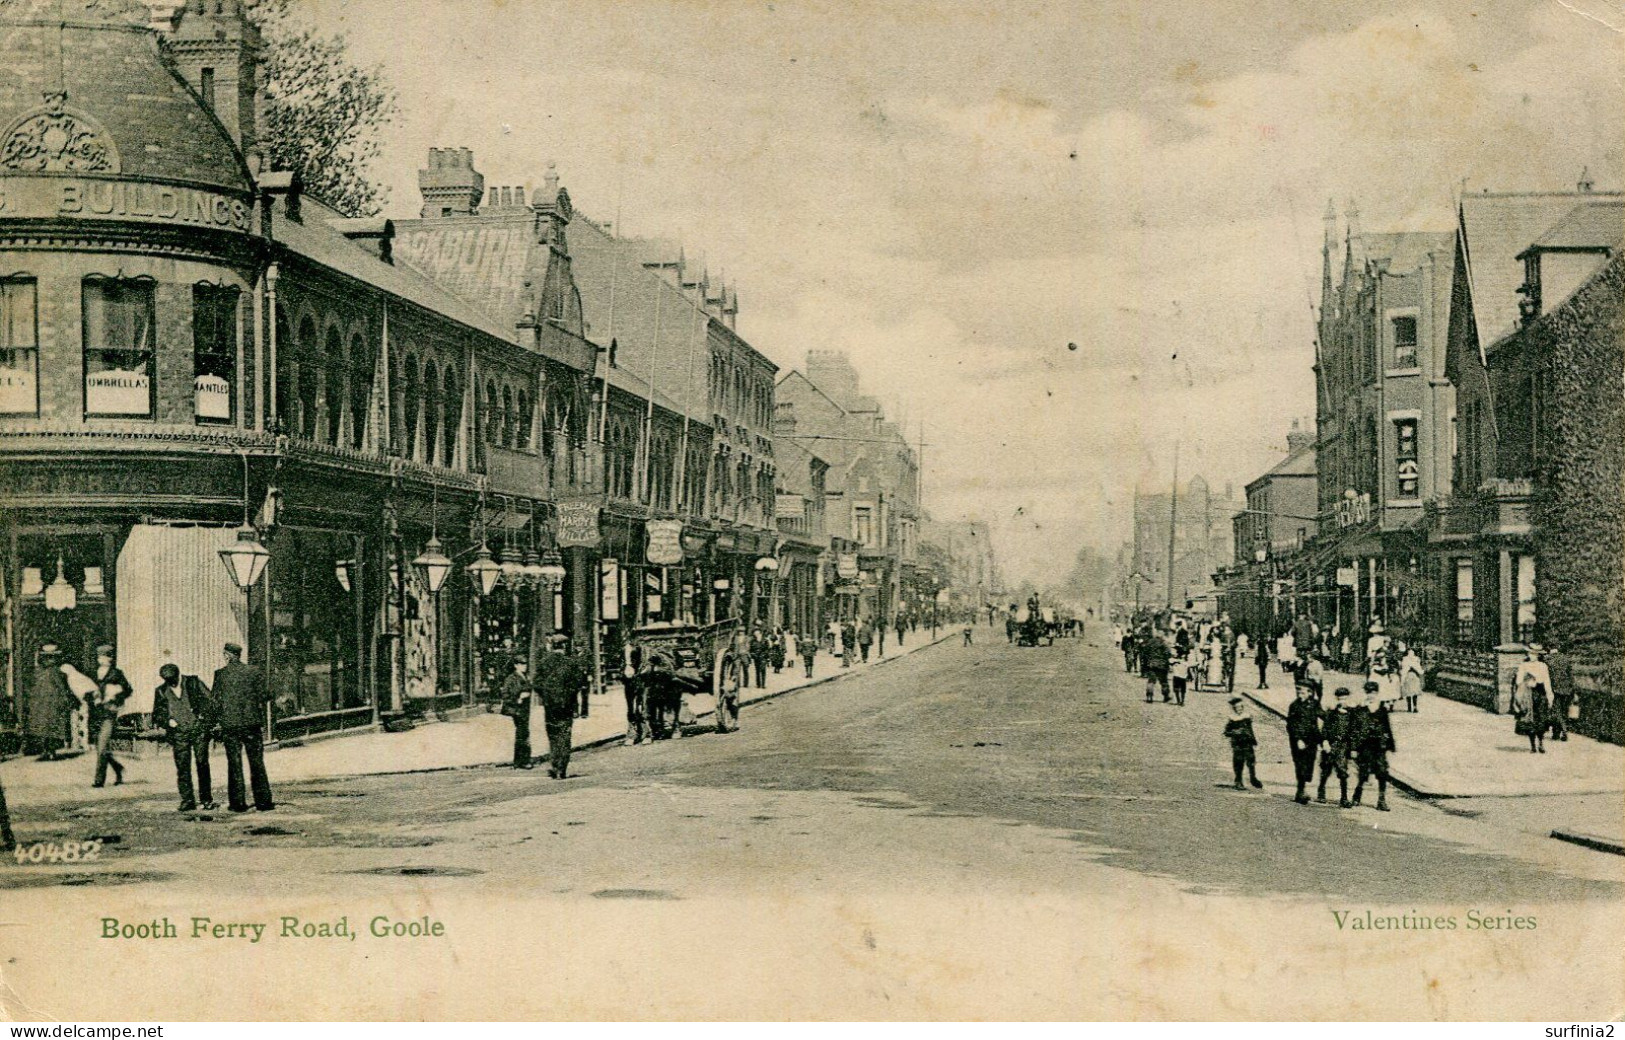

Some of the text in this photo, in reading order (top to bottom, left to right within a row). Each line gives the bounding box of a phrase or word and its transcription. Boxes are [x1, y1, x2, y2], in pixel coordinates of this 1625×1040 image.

[88, 377, 148, 389] UMBRELLAS
[557, 500, 599, 514] FREEMAN
[558, 529, 597, 542] WILLIS
